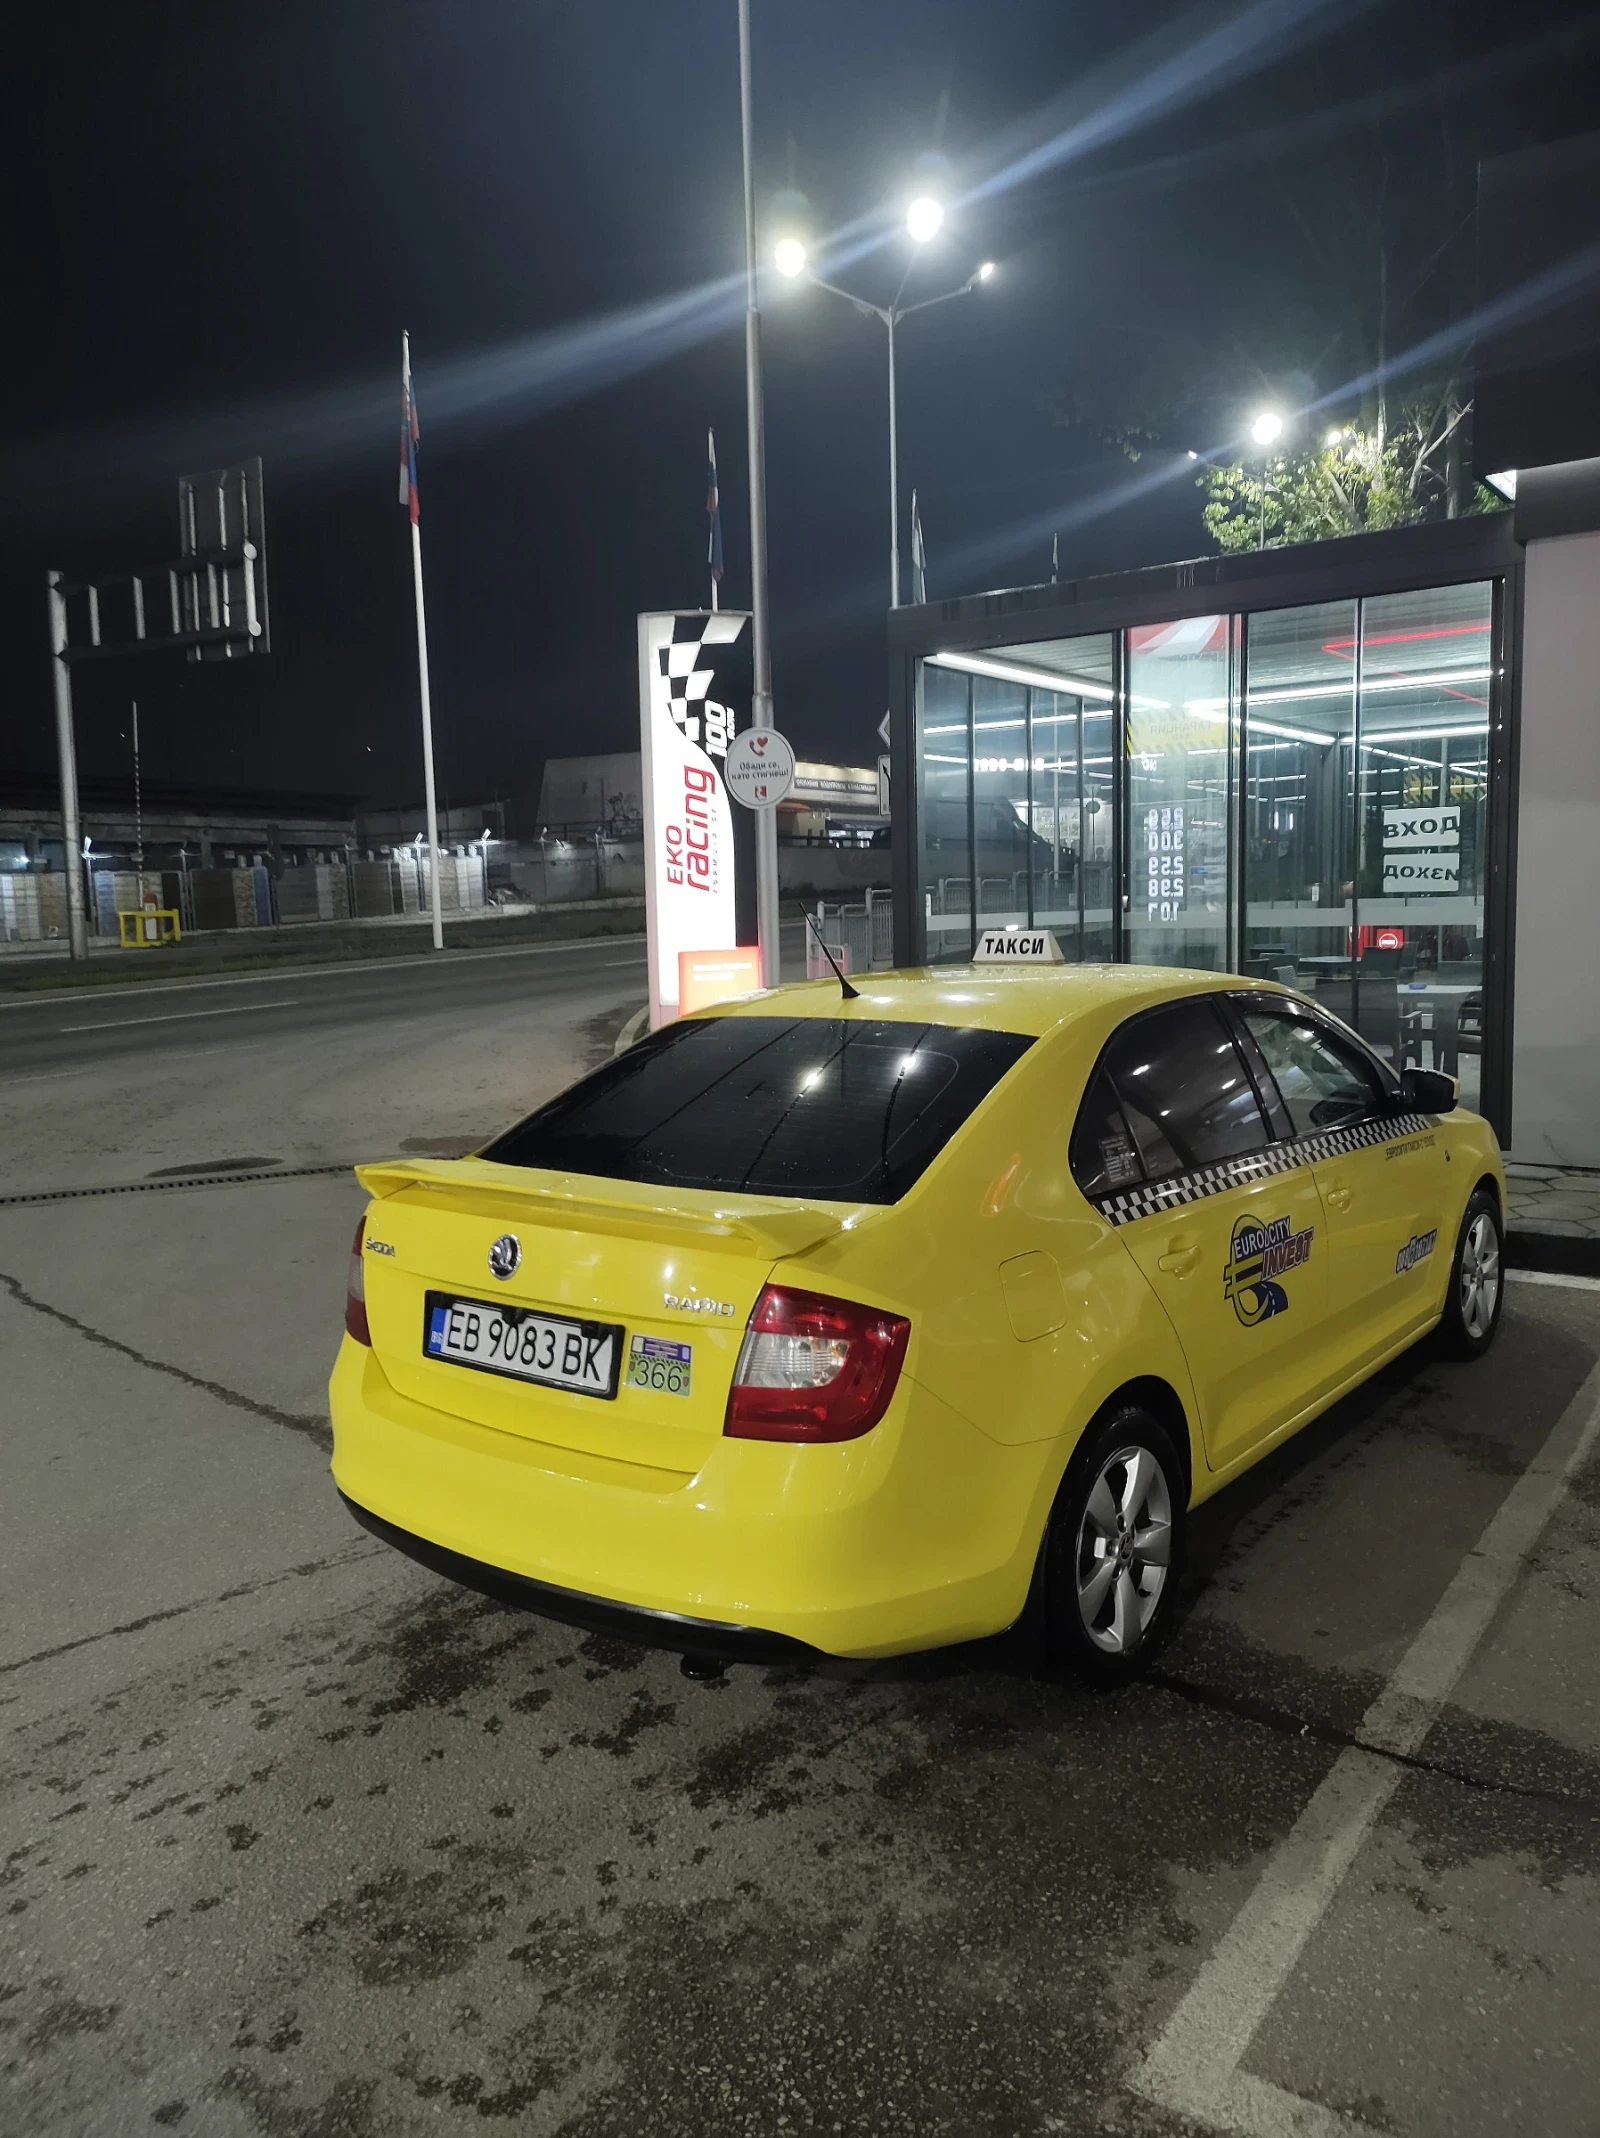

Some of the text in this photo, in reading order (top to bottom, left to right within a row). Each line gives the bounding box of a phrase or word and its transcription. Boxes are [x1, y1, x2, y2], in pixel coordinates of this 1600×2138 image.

[704, 699, 728, 758] 100
[739, 760, 766, 771] Обади
[684, 764, 716, 892] racing
[1384, 815, 1460, 839] ВХОД
[665, 824, 684, 886] EKO
[985, 937, 1045, 955] ТАКСИ
[1262, 1227, 1314, 1281] INVEST
[664, 1293, 735, 1317] RAPID
[447, 1310, 613, 1383] EB 9083 BK
[634, 1359, 683, 1393] 366
